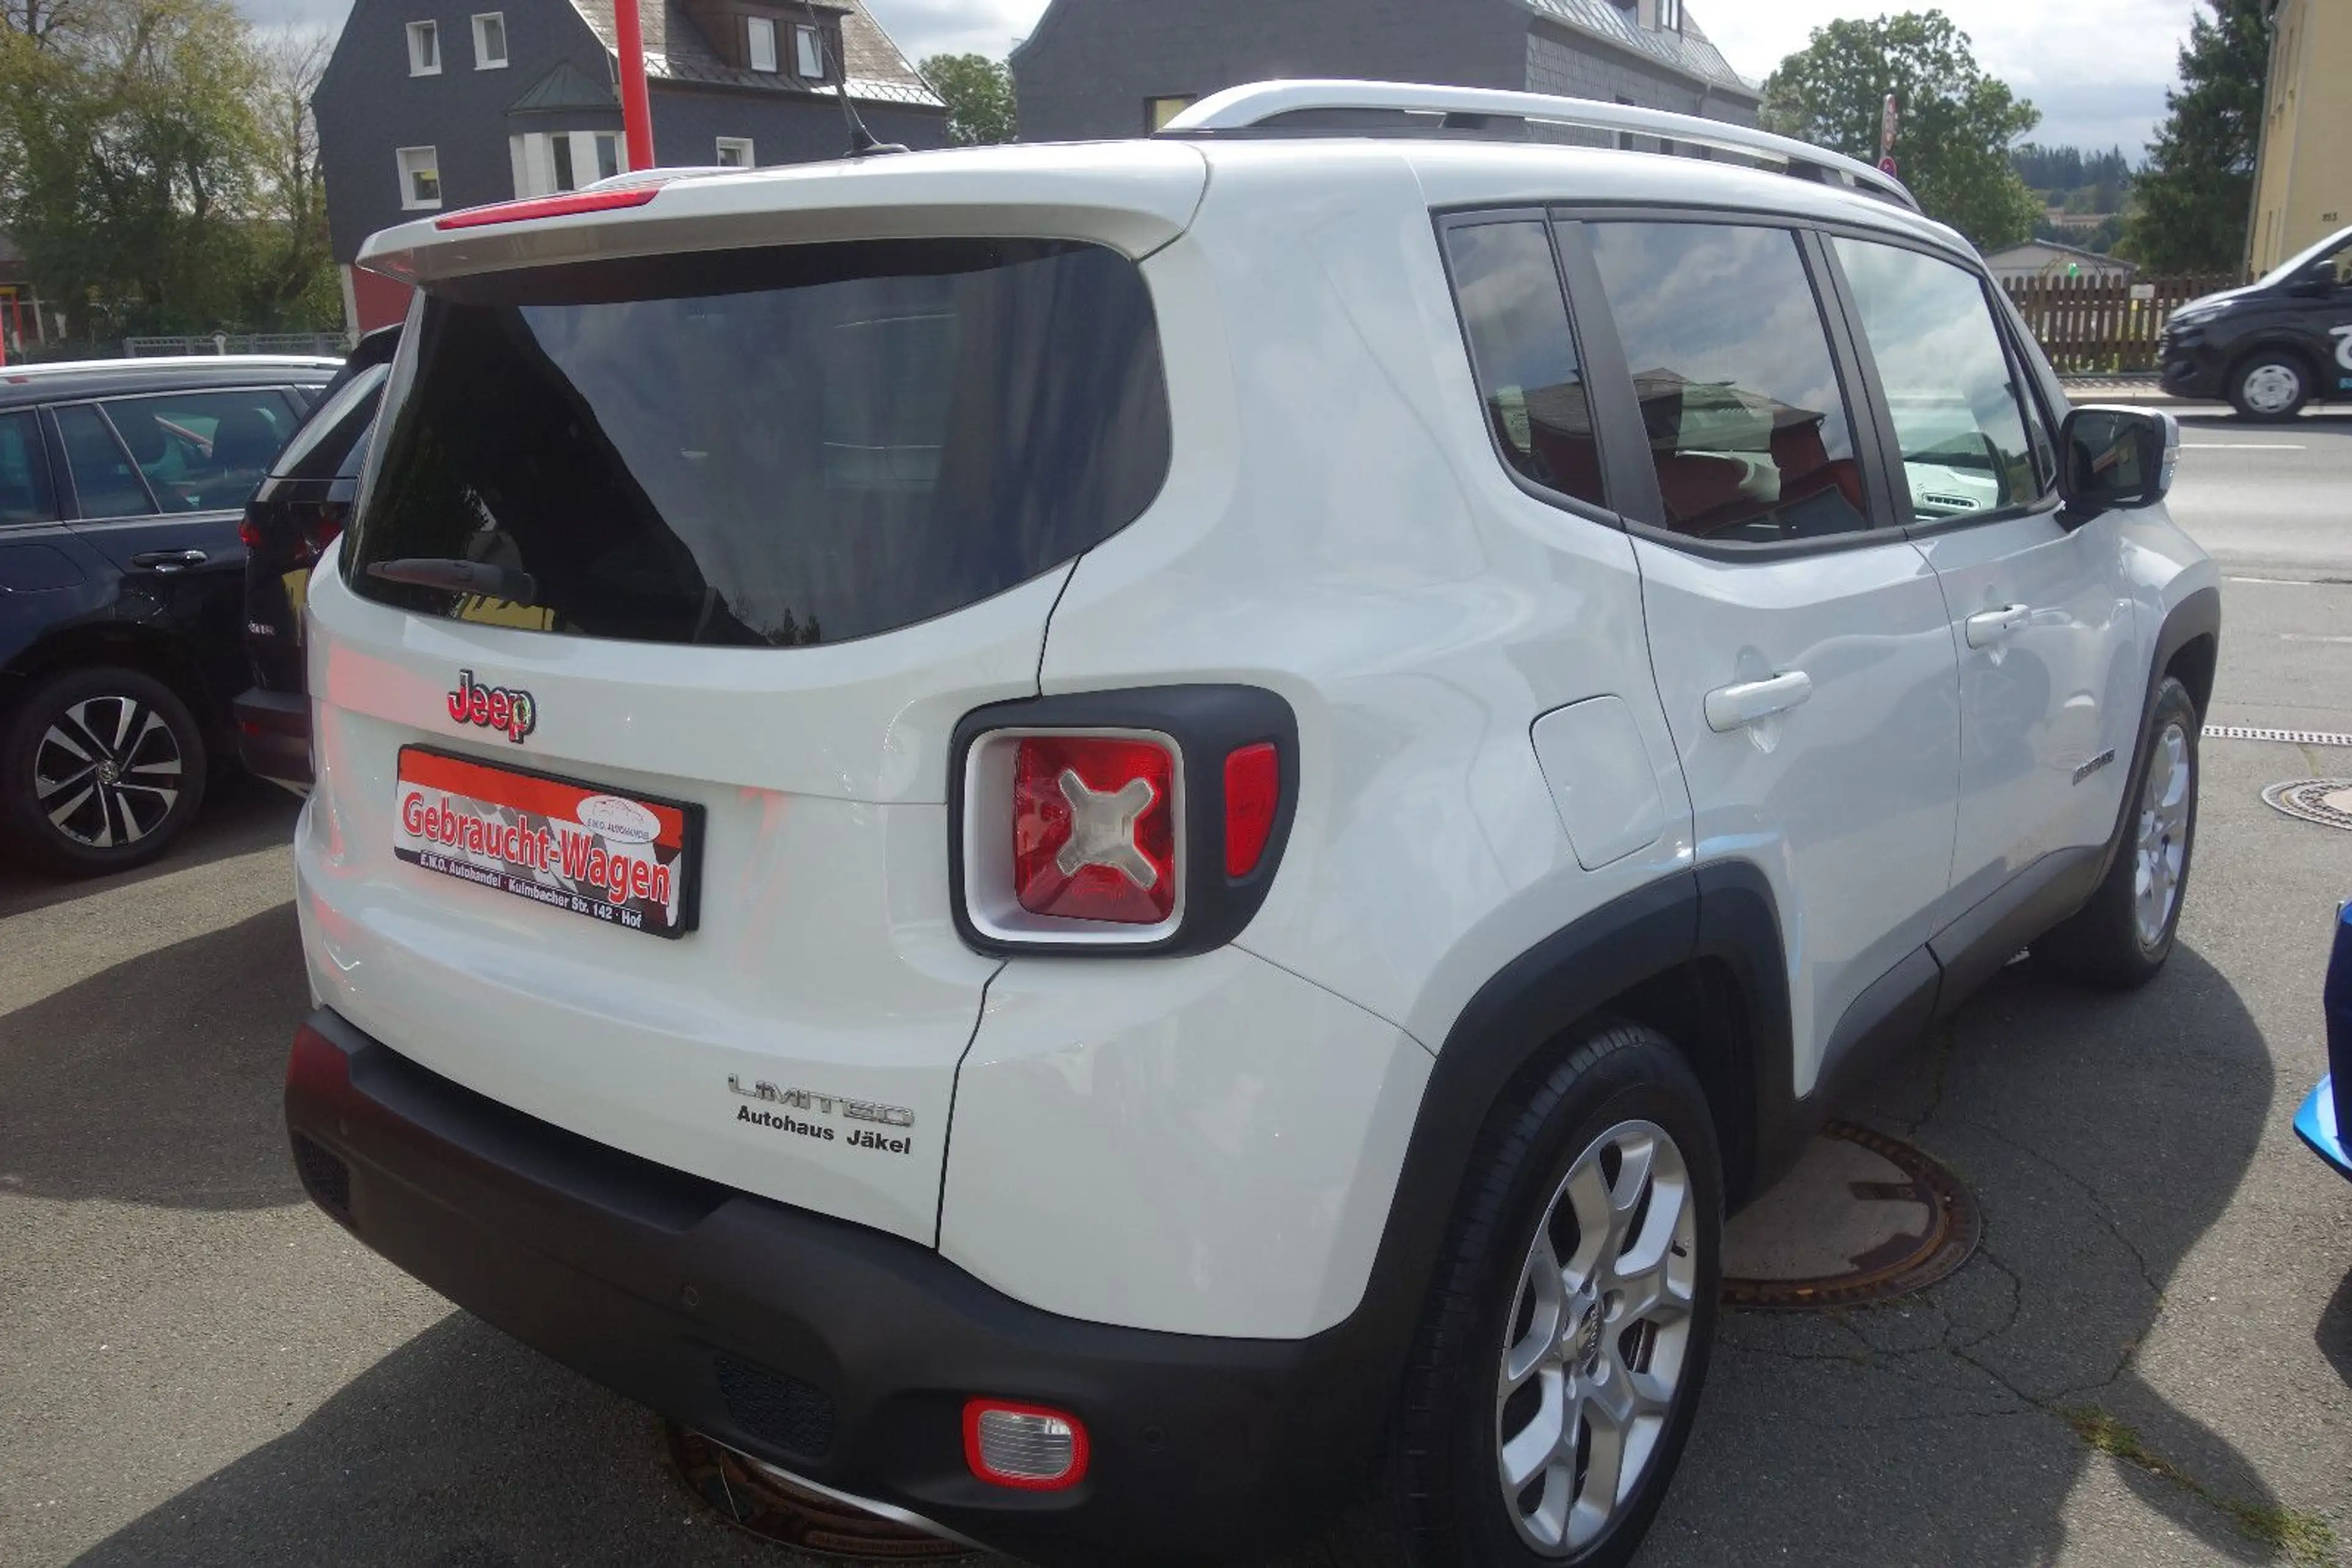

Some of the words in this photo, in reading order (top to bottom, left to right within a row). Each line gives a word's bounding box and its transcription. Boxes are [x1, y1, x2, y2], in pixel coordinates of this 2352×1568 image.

[447, 669, 535, 744] Jeep
[402, 791, 670, 905] Gebraucht-Wagen
[449, 861, 500, 887] Autohandel
[508, 879, 570, 907] Kulmbacher
[571, 896, 589, 913] Str.
[592, 904, 612, 919] 142
[622, 910, 642, 928] Hof
[728, 1072, 915, 1127] LIMITED
[737, 1105, 834, 1141] Autohaus
[846, 1129, 911, 1155] Jäkel
